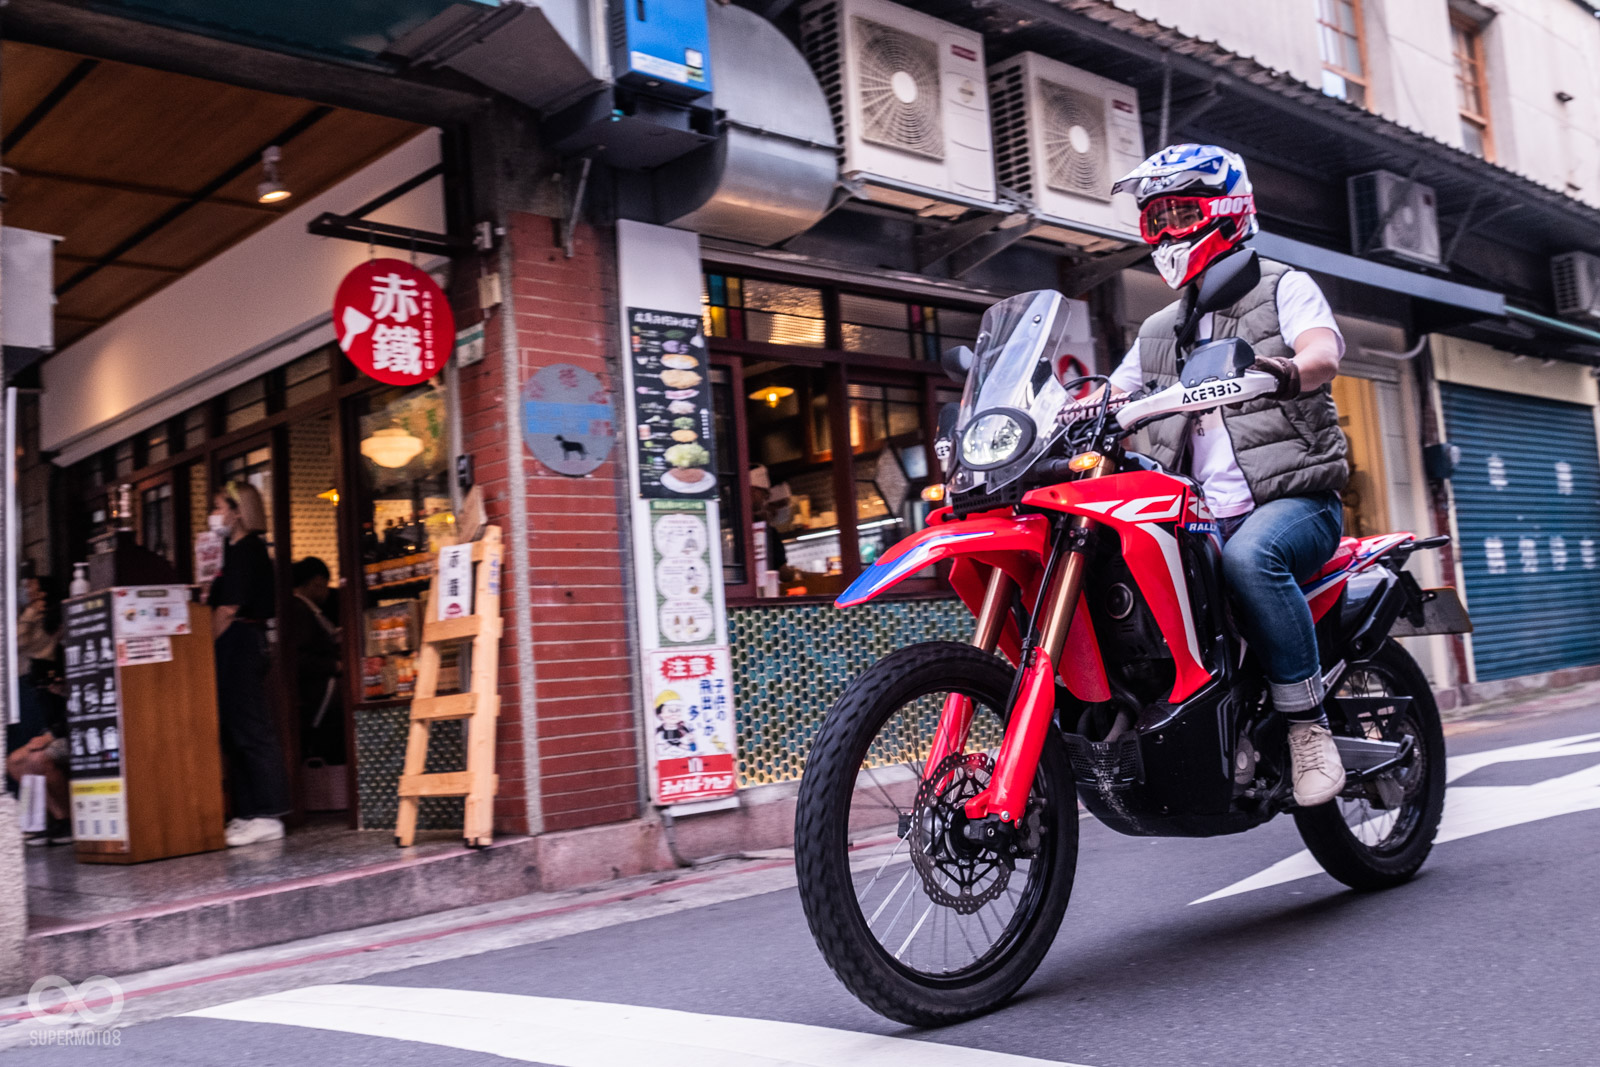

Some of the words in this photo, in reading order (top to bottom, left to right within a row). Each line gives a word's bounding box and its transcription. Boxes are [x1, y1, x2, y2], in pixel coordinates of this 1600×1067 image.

[1208, 195, 1254, 215] 100%
[422, 291, 435, 370] AKATETSU
[667, 658, 708, 676] 注意
[714, 679, 727, 721] 子供の
